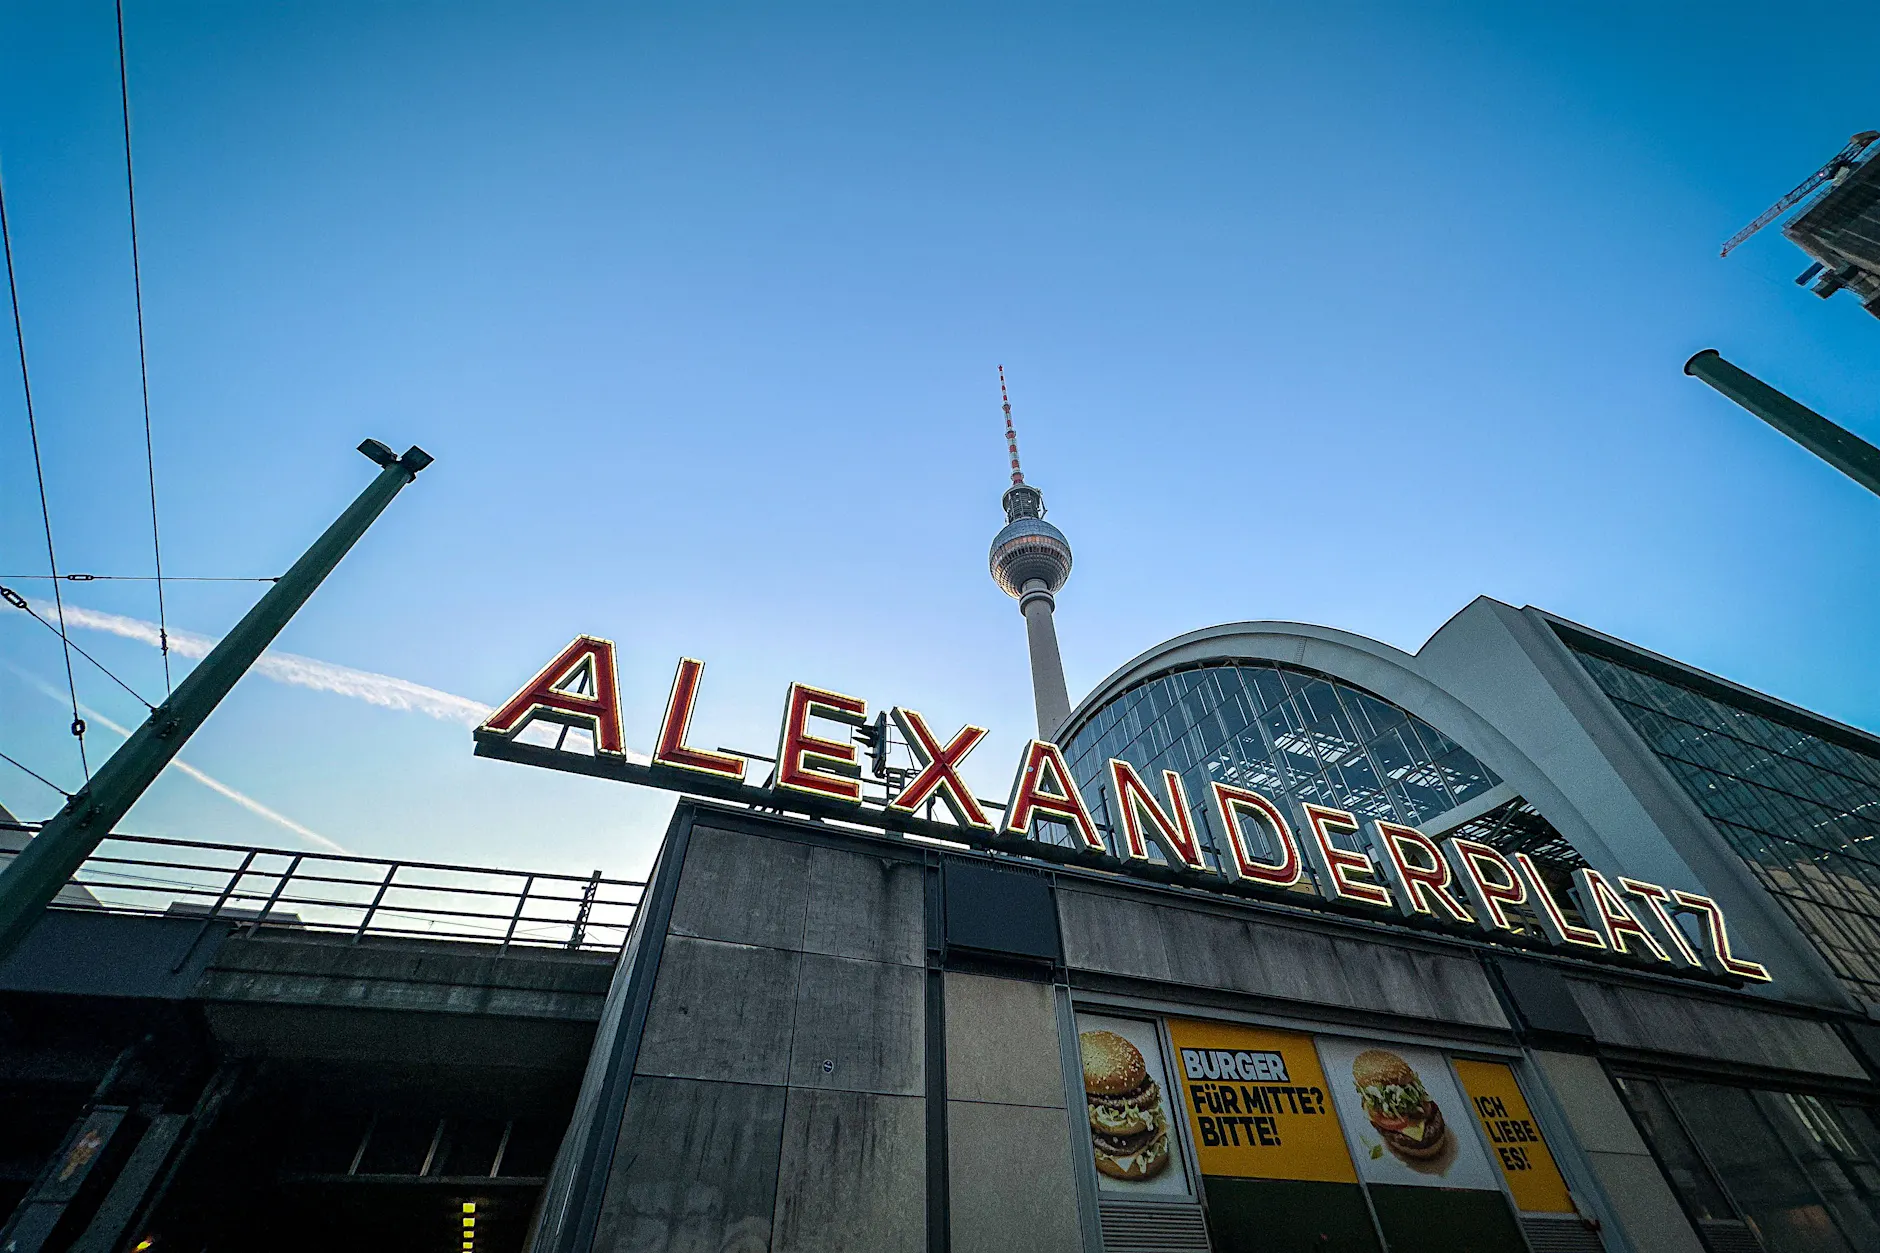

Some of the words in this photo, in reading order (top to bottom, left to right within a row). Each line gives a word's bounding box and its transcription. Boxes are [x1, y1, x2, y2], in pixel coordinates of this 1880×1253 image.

[473, 633, 1773, 983] ALEXANDERPLATZ
[1181, 1050, 1289, 1081] BURGER
[1239, 1085, 1326, 1115] MITTE?
[1473, 1096, 1509, 1118] ICH
[1197, 1116, 1282, 1147] BITTE!
[1484, 1121, 1539, 1143] LIEBE
[1497, 1147, 1532, 1171] ES!
